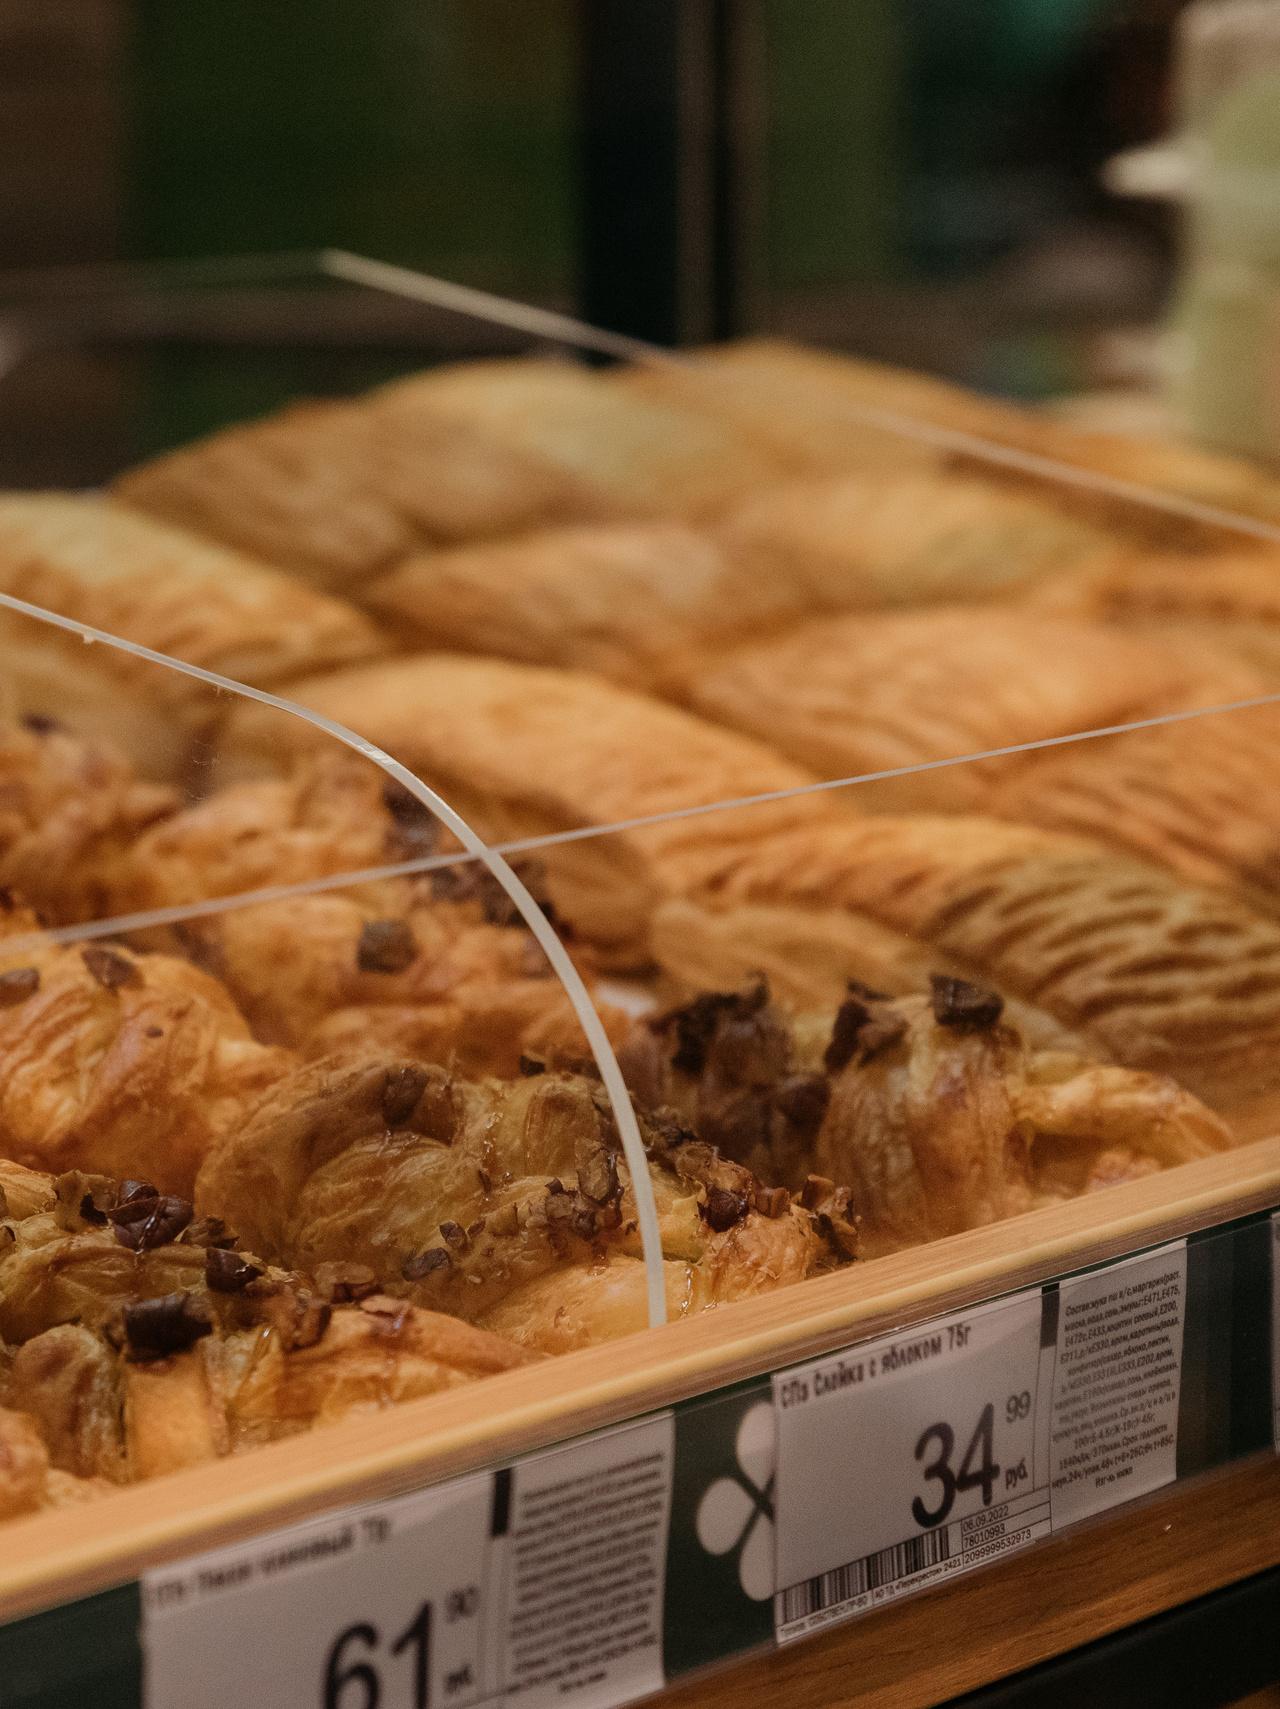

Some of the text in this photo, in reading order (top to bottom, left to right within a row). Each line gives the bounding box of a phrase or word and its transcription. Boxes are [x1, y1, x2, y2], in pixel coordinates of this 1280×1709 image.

[813, 1361, 864, 1397] Слойка
[870, 1360, 877, 1378] с
[881, 1334, 942, 1373] яблоком
[946, 1322, 972, 1350] 75г
[1006, 1390, 1031, 1423] 99
[912, 1403, 1000, 1528] 34
[963, 1505, 1009, 1532] 06.09.2022
[964, 1523, 1005, 1548] 78010993
[965, 1529, 1031, 1564] 2099999532973
[944, 1557, 962, 1573] 2421
[325, 1600, 433, 1709] 61
